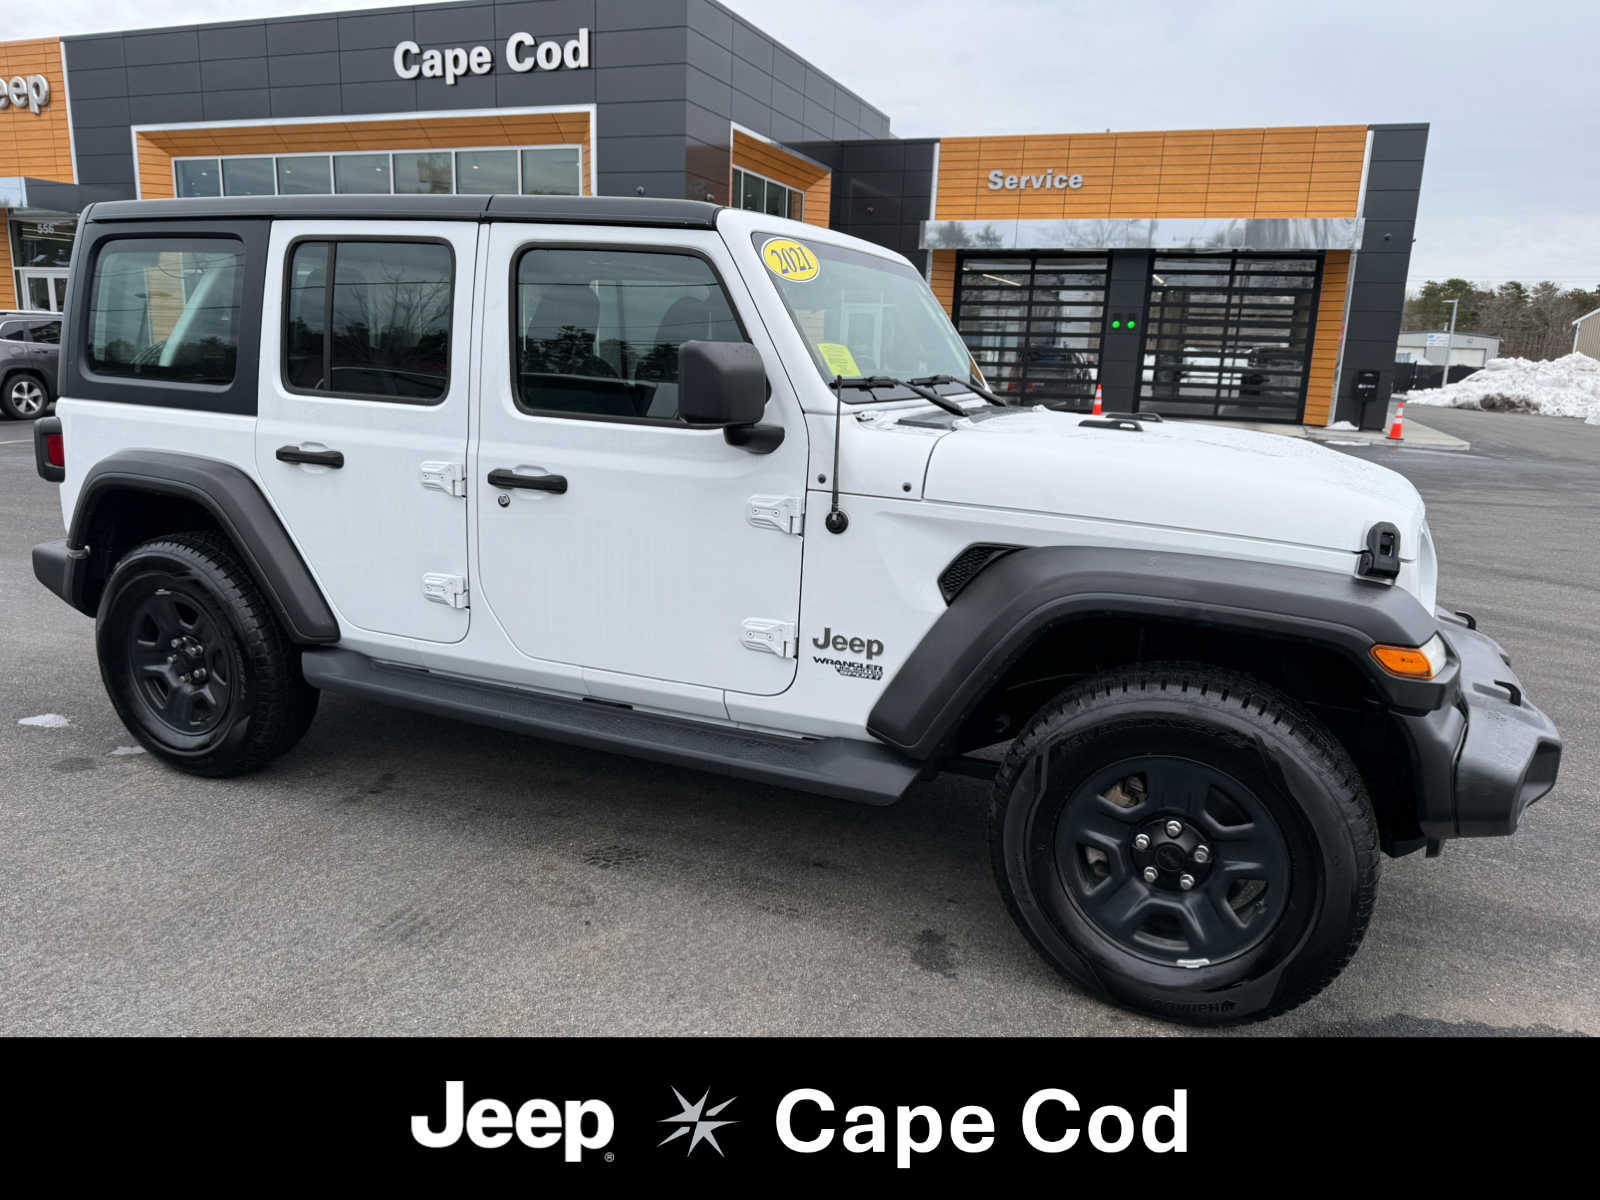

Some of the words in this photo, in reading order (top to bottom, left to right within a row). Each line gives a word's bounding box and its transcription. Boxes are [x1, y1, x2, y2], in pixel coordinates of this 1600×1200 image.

[393, 40, 493, 85] Cape
[505, 28, 591, 73] Cod
[988, 168, 1083, 190] Service
[770, 246, 815, 275] 2021
[812, 627, 884, 660] Jeep
[812, 656, 883, 671] WRANGLER
